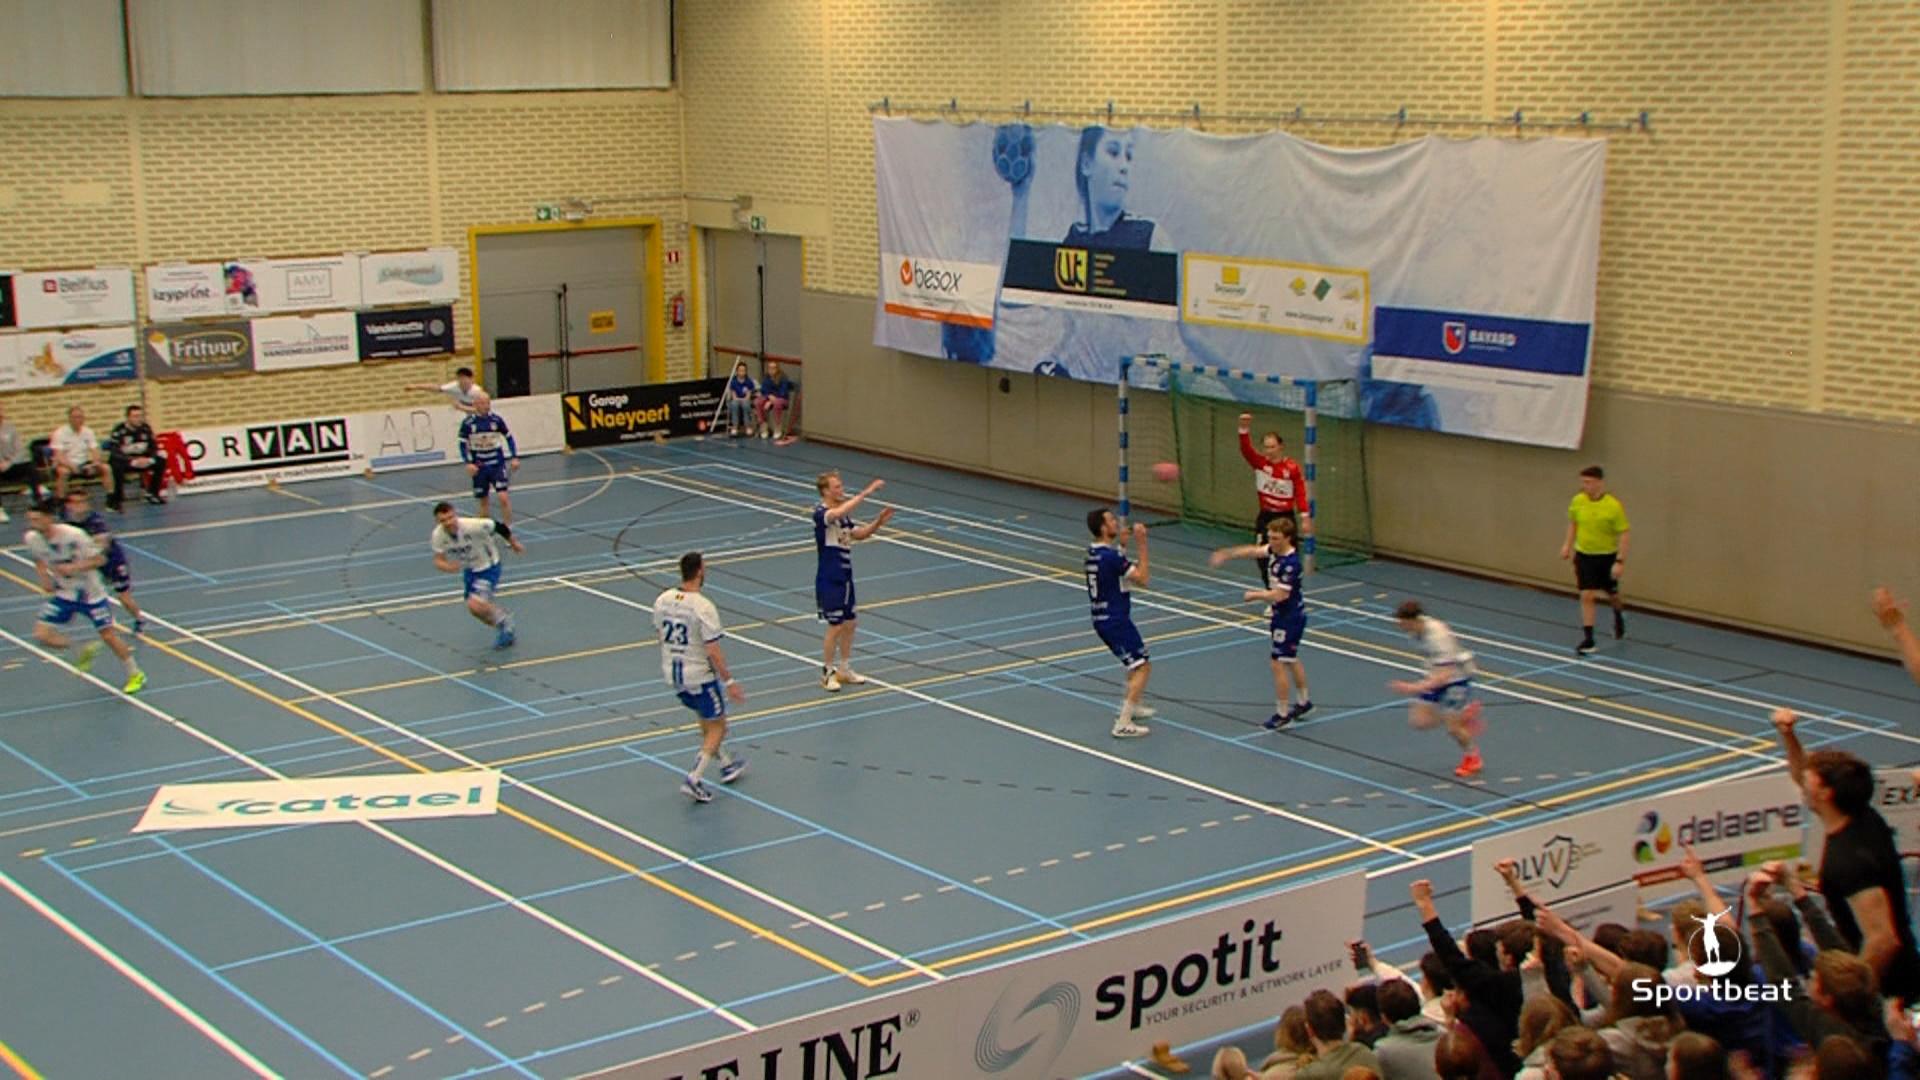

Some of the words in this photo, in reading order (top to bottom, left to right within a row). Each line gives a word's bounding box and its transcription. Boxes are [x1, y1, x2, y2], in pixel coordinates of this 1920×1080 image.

[173, 335, 241, 358] Frituur
[588, 393, 629, 409] Garage
[590, 403, 670, 431] Naeyaert
[662, 620, 689, 645] 23
[1678, 803, 1801, 847] delaere
[1095, 919, 1282, 1031] spotit
[1182, 990, 1236, 1017] SECURITY
